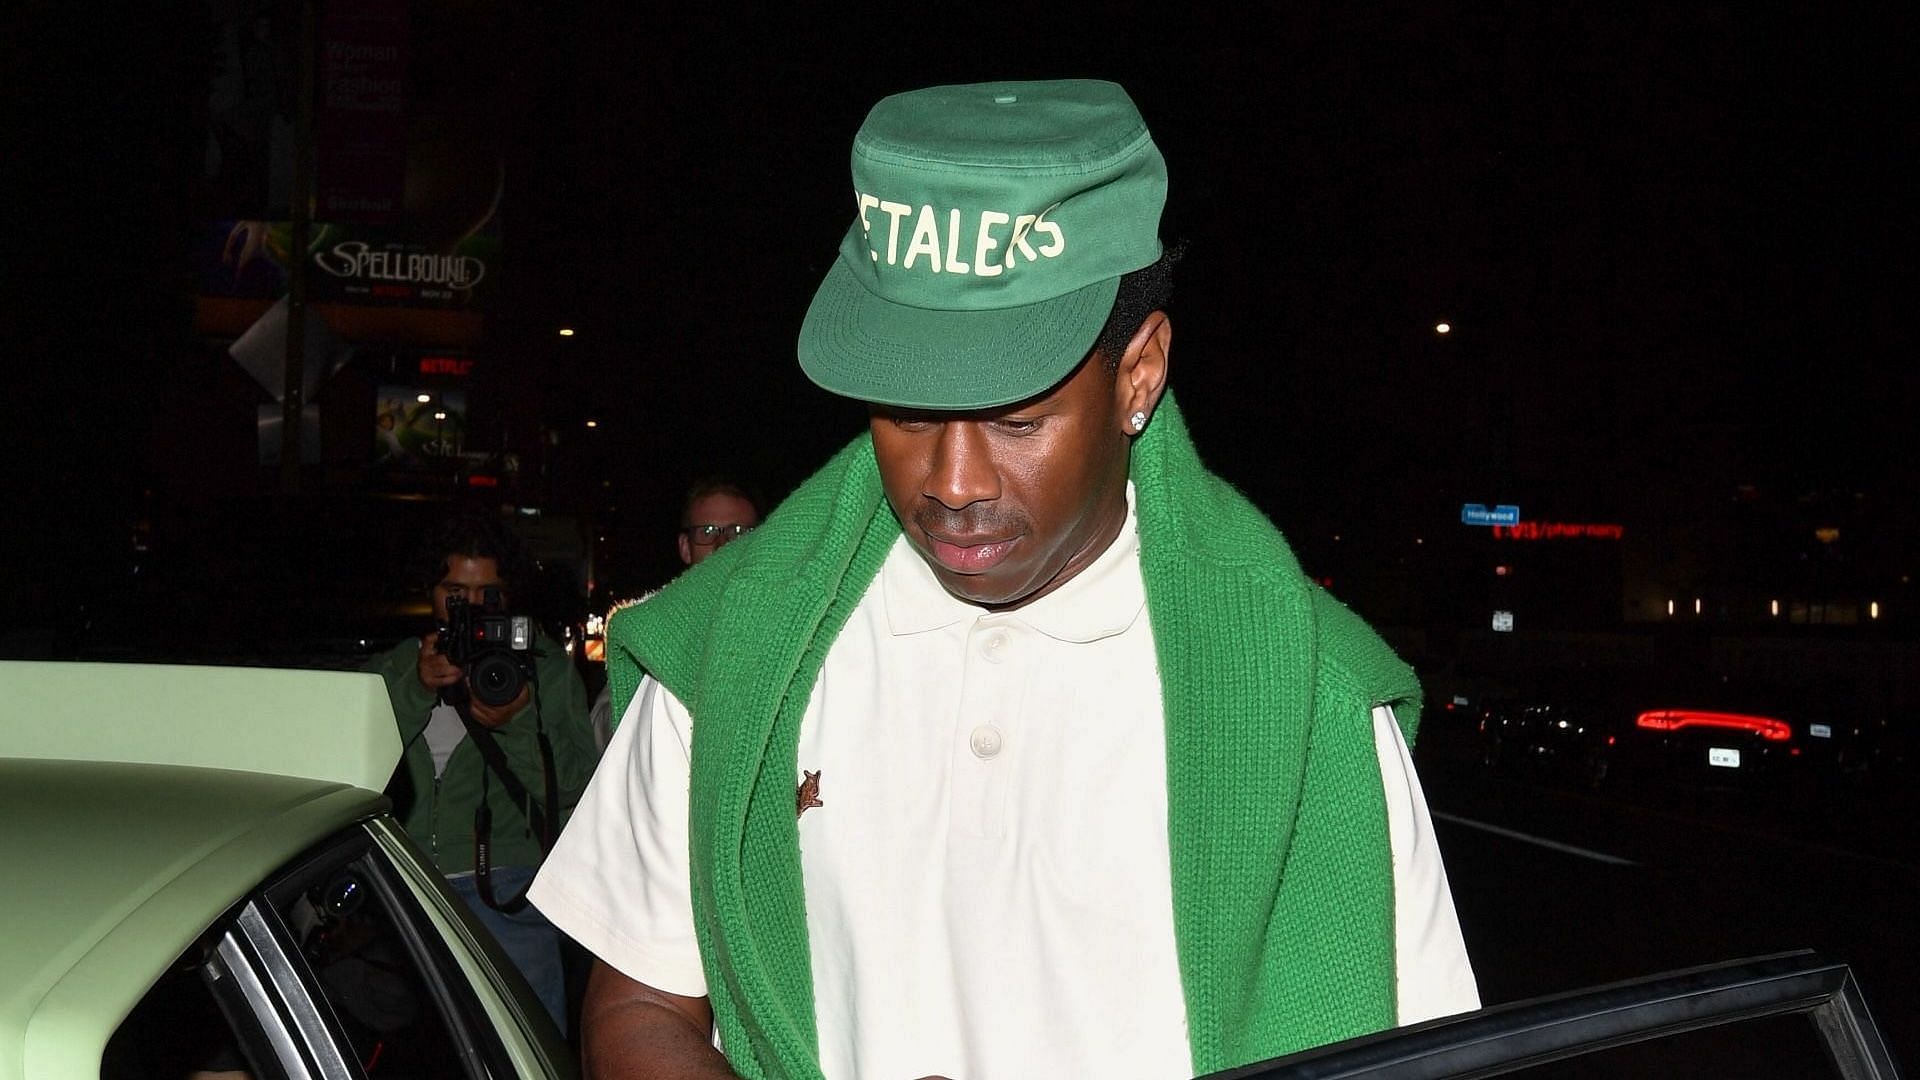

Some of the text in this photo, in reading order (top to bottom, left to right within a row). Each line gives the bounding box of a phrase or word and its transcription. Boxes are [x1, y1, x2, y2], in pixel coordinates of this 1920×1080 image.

[855, 190, 1065, 277] ETALERS
[314, 240, 486, 290] SPELLBOUND
[1466, 509, 1514, 521] Hollywood
